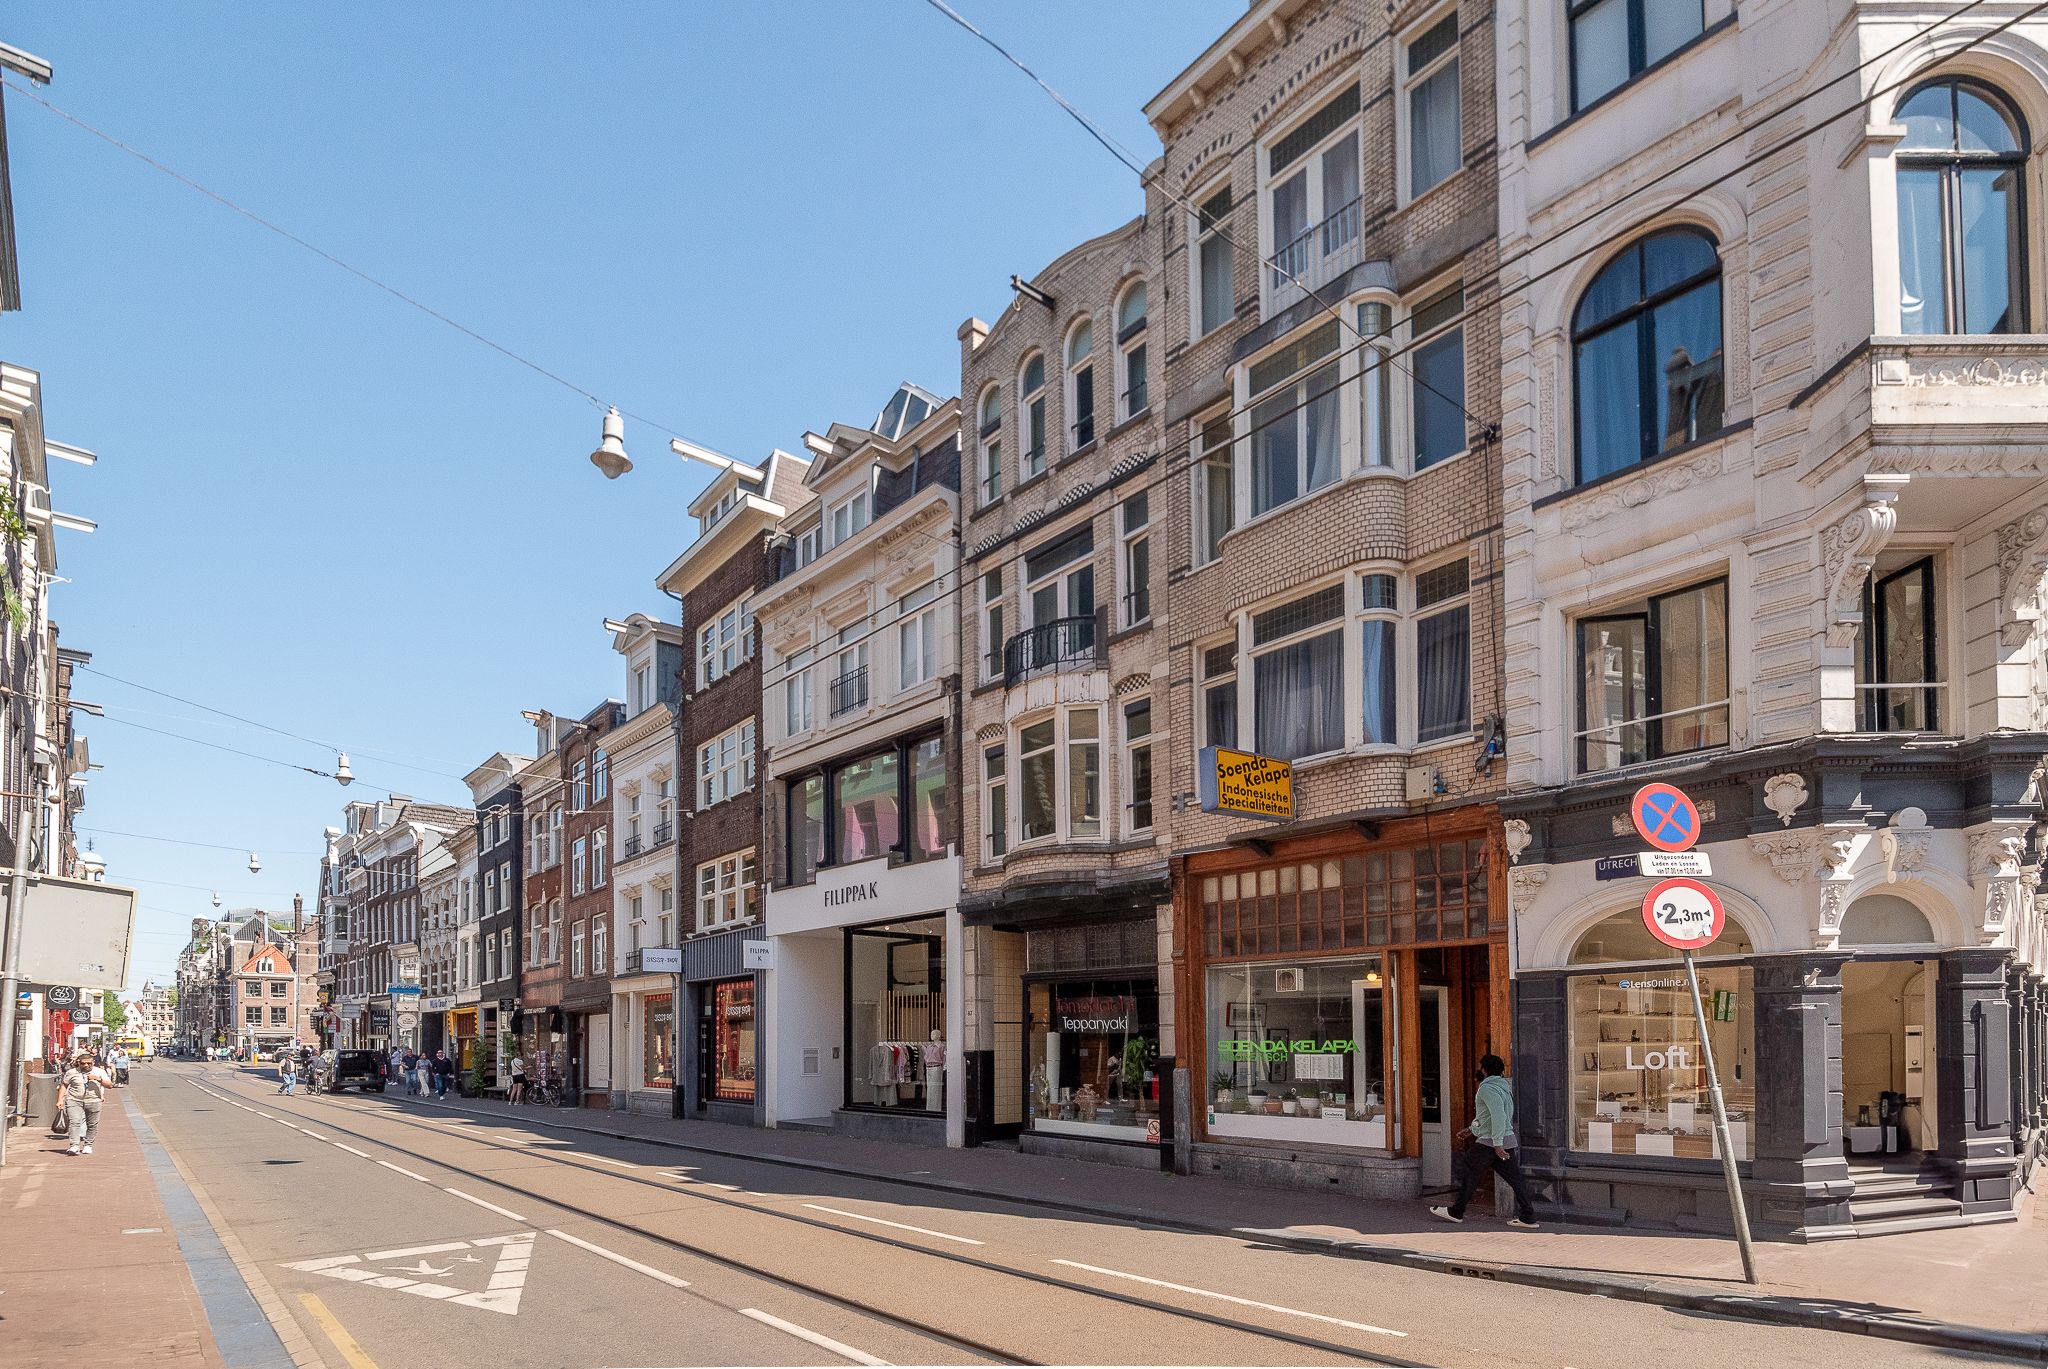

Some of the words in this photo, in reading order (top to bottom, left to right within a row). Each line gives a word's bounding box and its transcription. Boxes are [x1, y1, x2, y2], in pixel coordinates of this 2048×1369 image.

[1217, 755, 1268, 778] Soenda
[1243, 767, 1290, 787] Kelapa
[1222, 782, 1289, 803] Indonesische
[1221, 794, 1290, 815] Specialiteiten
[1598, 858, 1637, 870] UTRECH
[824, 884, 867, 907] FILIPPA
[869, 881, 878, 899] K
[1662, 903, 1703, 925] 2,3m
[1630, 978, 1690, 989] LensOnline.n
[1062, 1016, 1129, 1032] Teppanyaki
[1218, 1040, 1288, 1053] SOENDA
[1290, 1040, 1360, 1053] KELAPA
[1625, 1046, 1690, 1070] Loft
